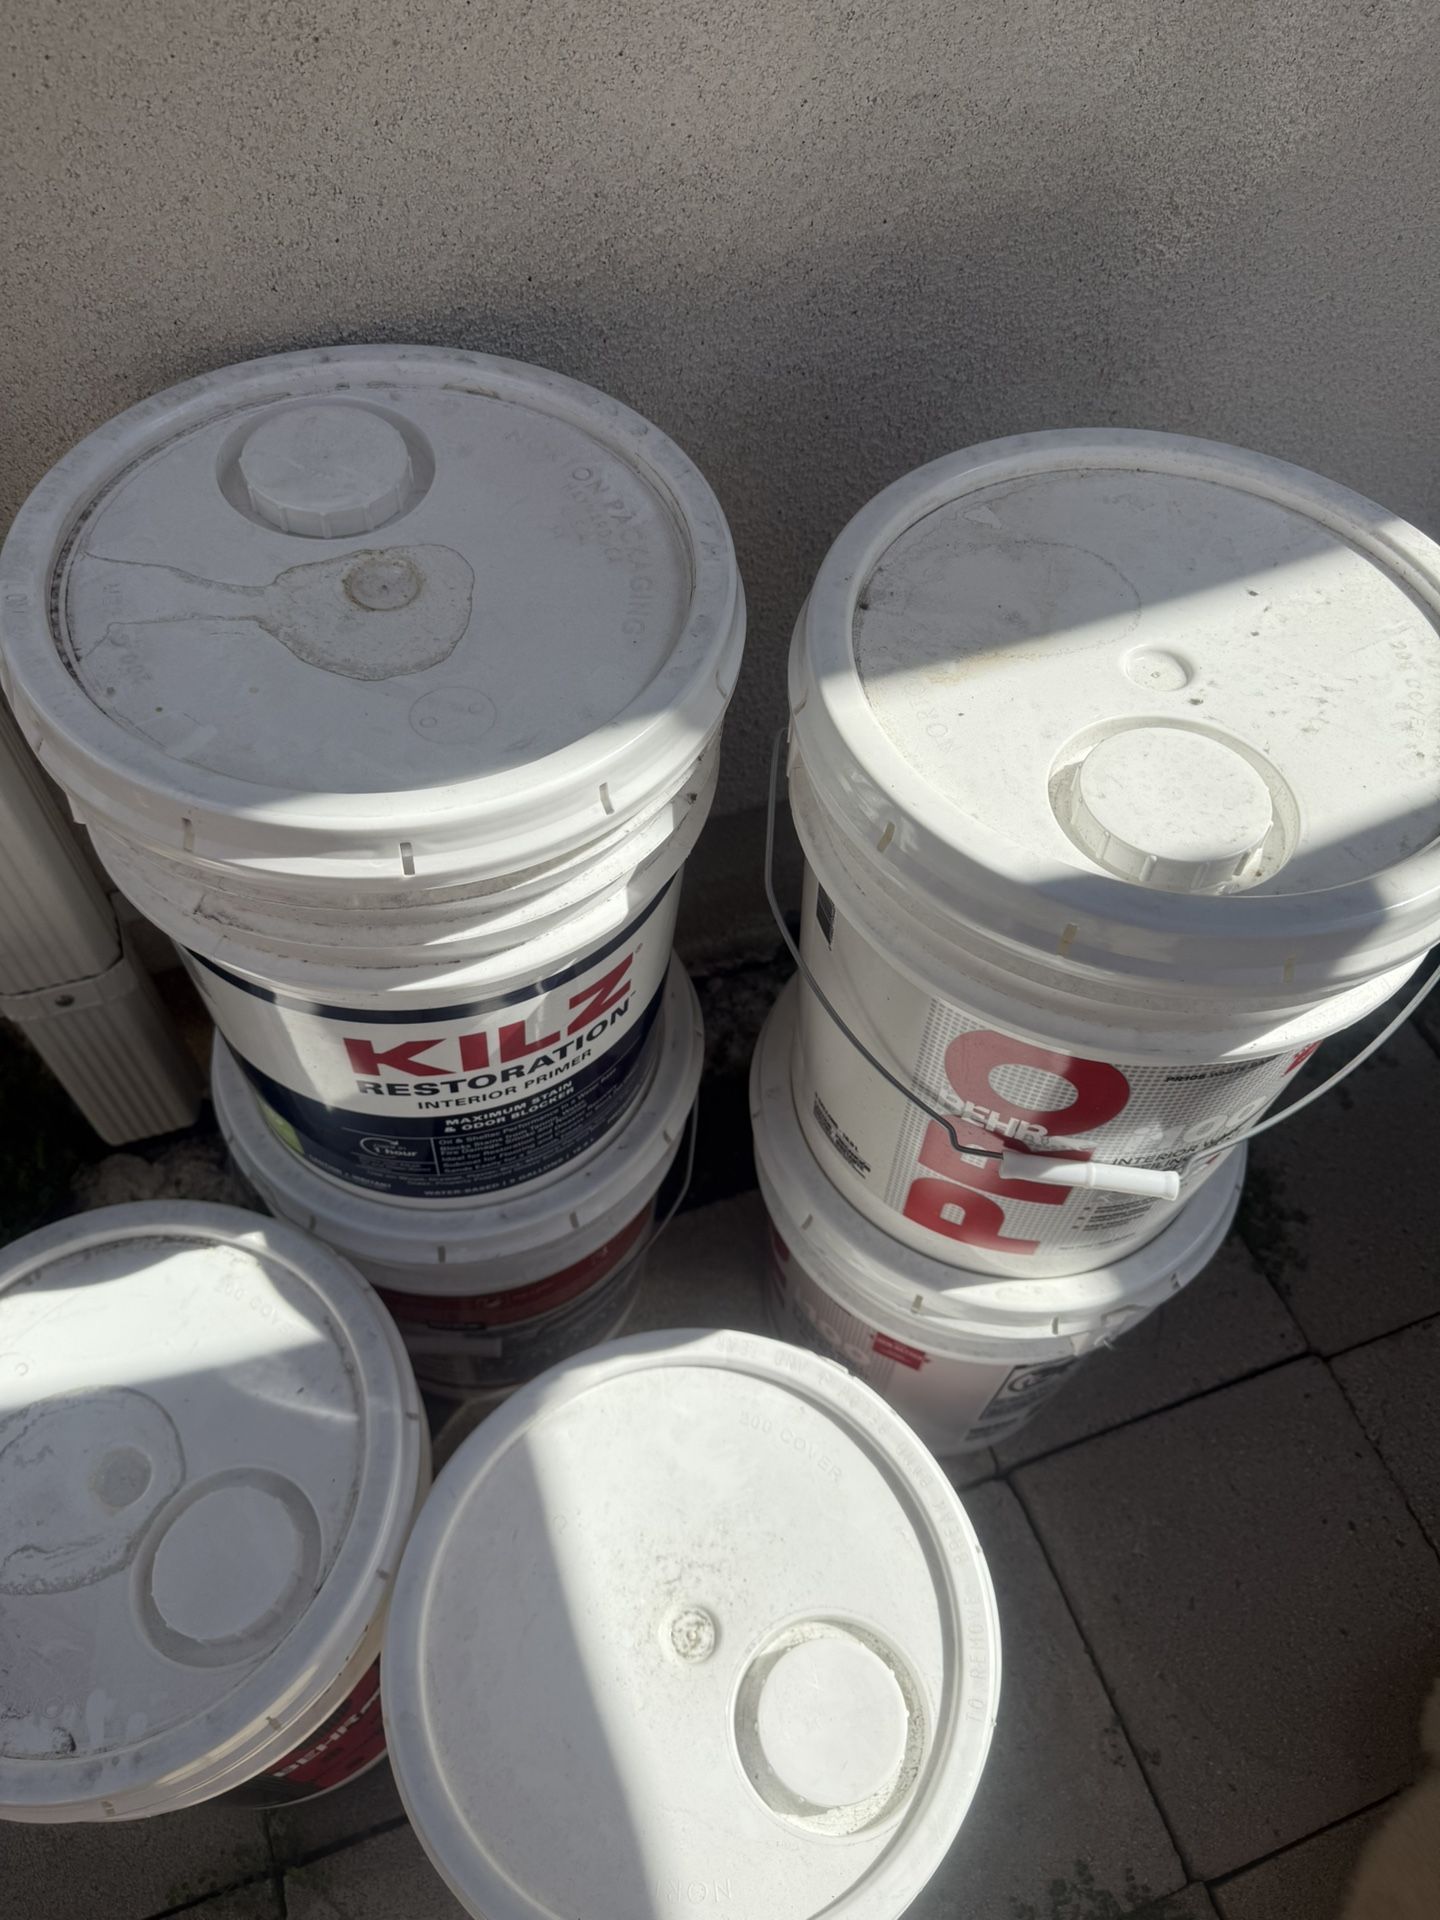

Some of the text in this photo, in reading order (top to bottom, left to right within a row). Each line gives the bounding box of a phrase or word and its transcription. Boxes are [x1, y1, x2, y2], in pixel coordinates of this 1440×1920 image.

[343, 952, 633, 1077] KILZ
[356, 997, 631, 1097] RESTORATION
[417, 1085, 517, 1110] INTERIOR
[523, 1048, 592, 1090] PRIMER
[444, 1102, 527, 1126] MAXIMUM
[531, 1080, 573, 1105] STAIN
[462, 1116, 506, 1132] ODOR
[509, 1087, 576, 1119] BLOCKER
[938, 1087, 1050, 1143] BEHR
[1112, 1144, 1199, 1166] INTERIOR
